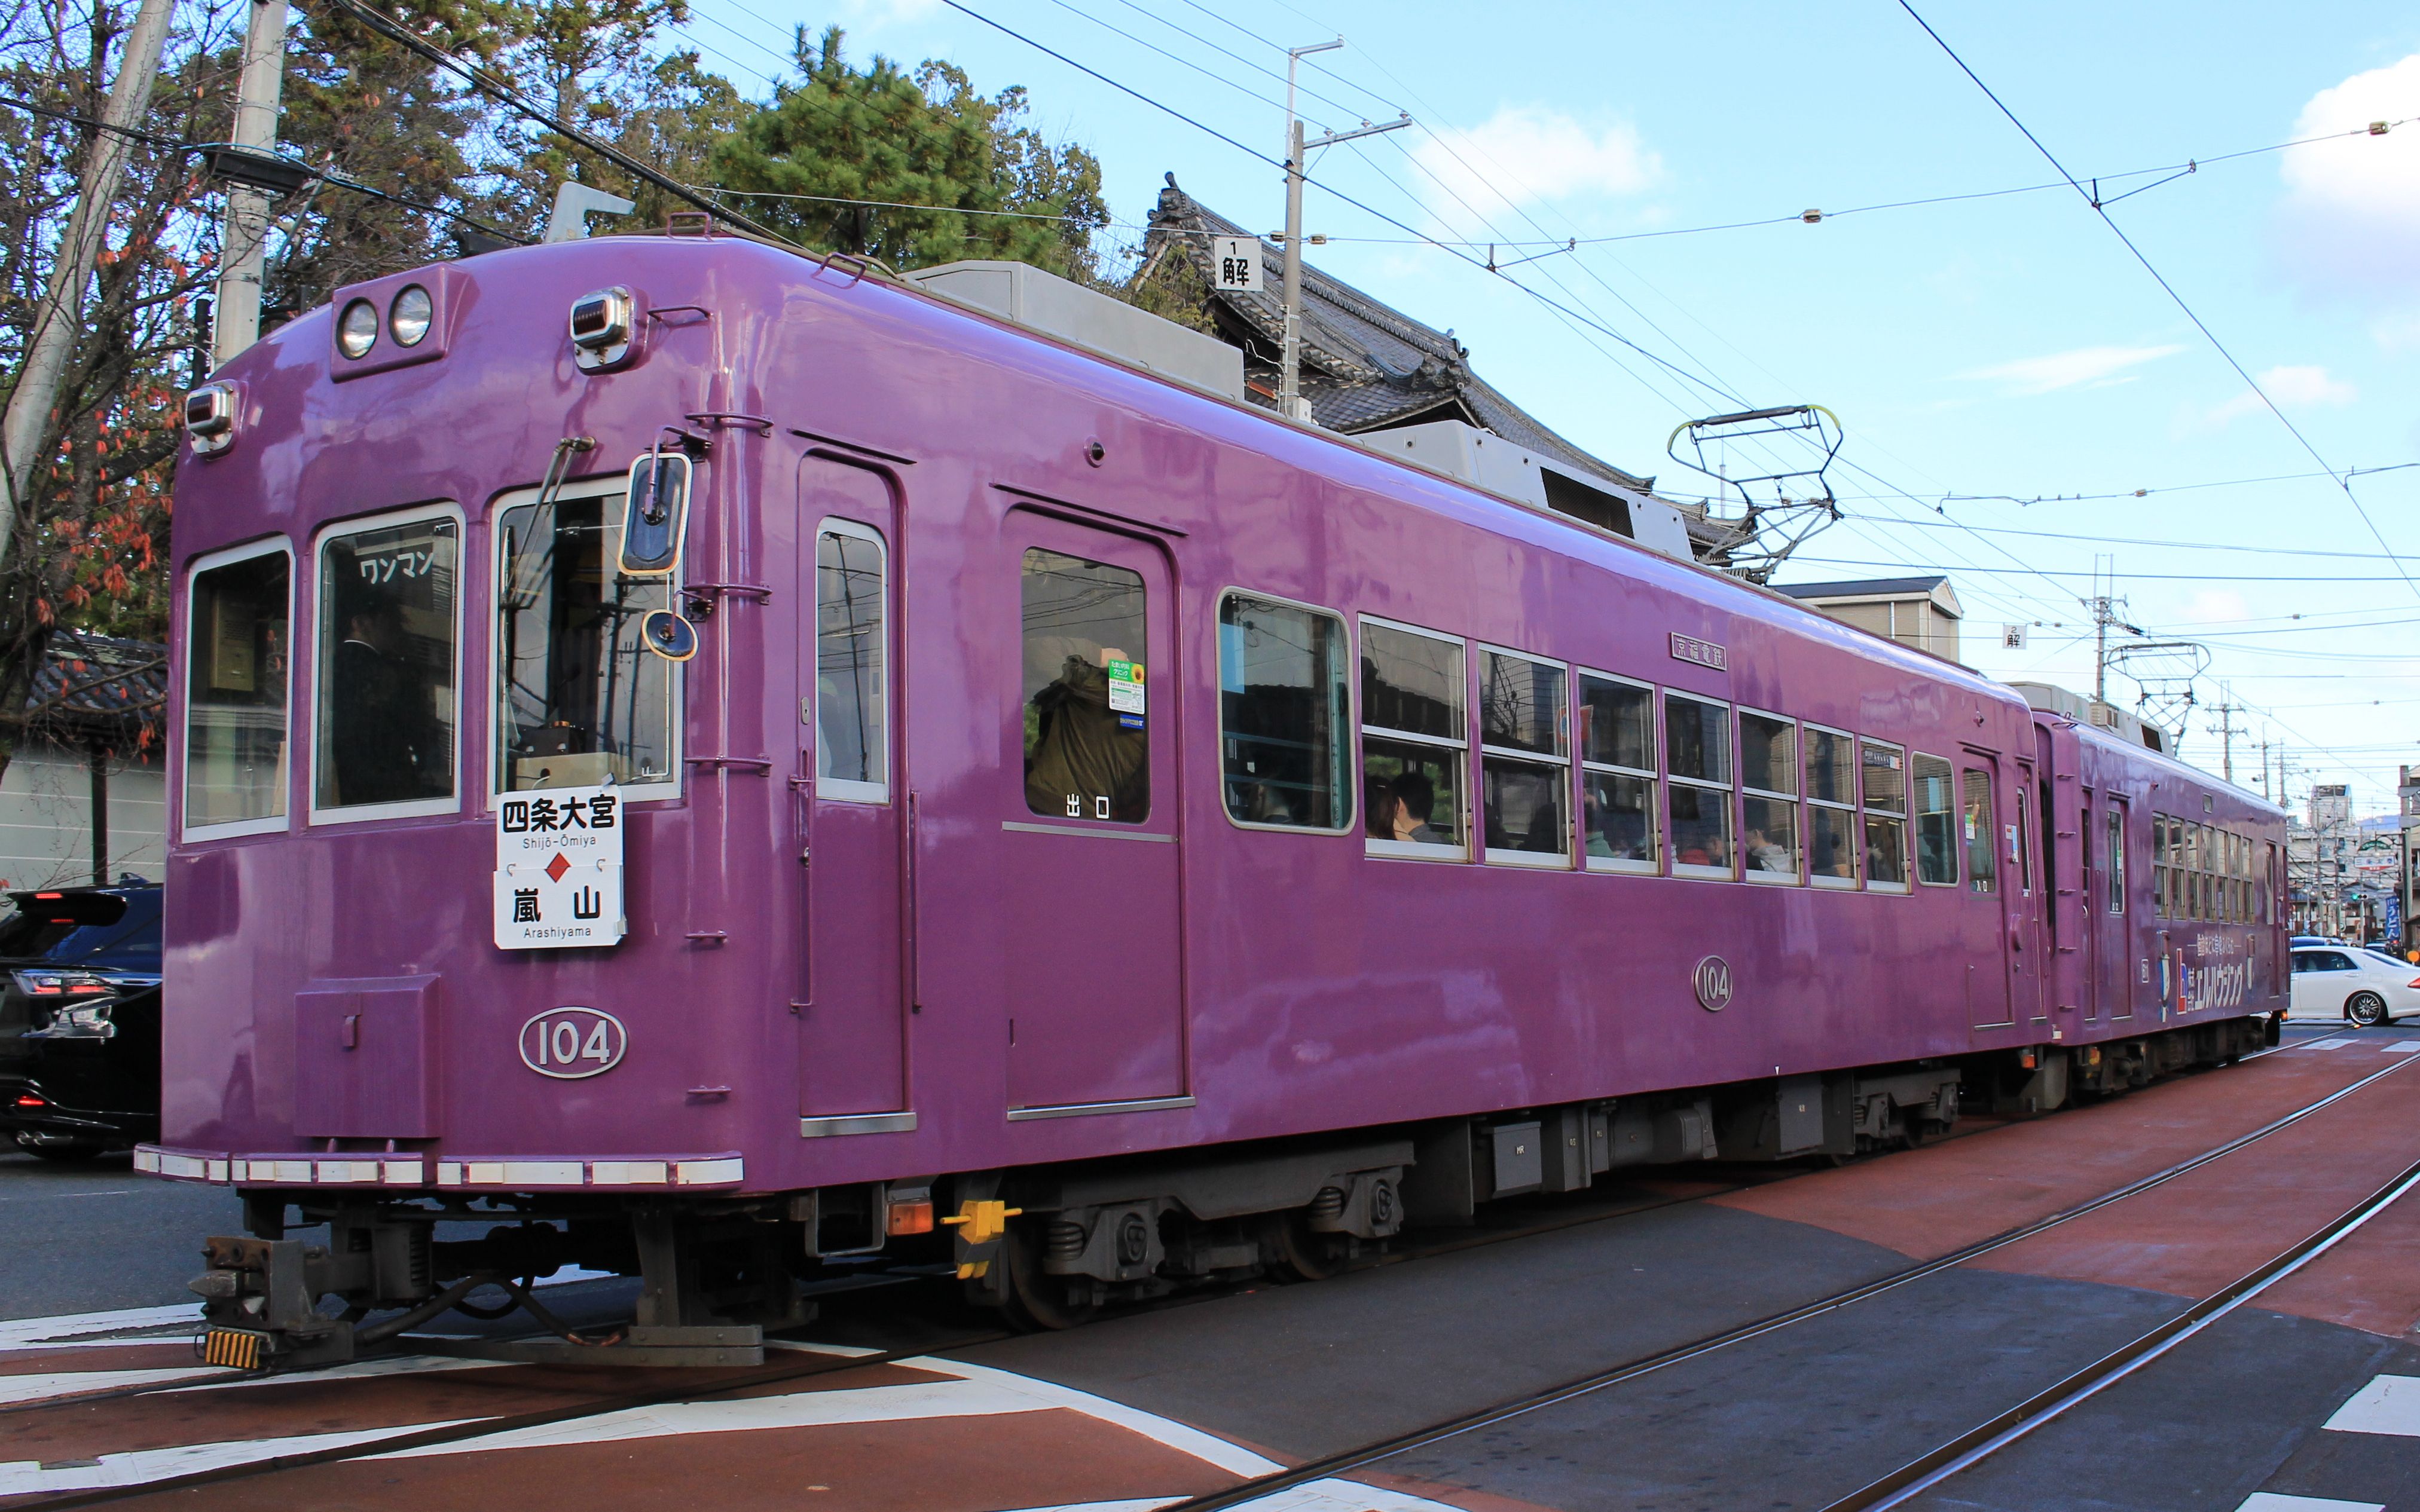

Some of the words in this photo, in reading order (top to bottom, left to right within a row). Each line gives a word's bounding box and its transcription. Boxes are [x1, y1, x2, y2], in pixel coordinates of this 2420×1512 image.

[1230, 241, 1236, 255] 1
[1223, 257, 1249, 286] 解
[360, 551, 434, 584] ワンマン
[2007, 634, 2020, 647] 解
[503, 794, 616, 833] 四条大宮
[1067, 793, 1110, 819] 出口
[523, 834, 597, 850] Shijō-Ōmiya
[1976, 880, 1988, 892] 入口
[514, 885, 601, 923] 嵐山
[524, 927, 592, 939] Arashiyama
[1703, 966, 1729, 1000] 104
[2194, 963, 2242, 1011] エルハウジング
[539, 1020, 610, 1065] 104
[1517, 1145, 1524, 1155] MR
